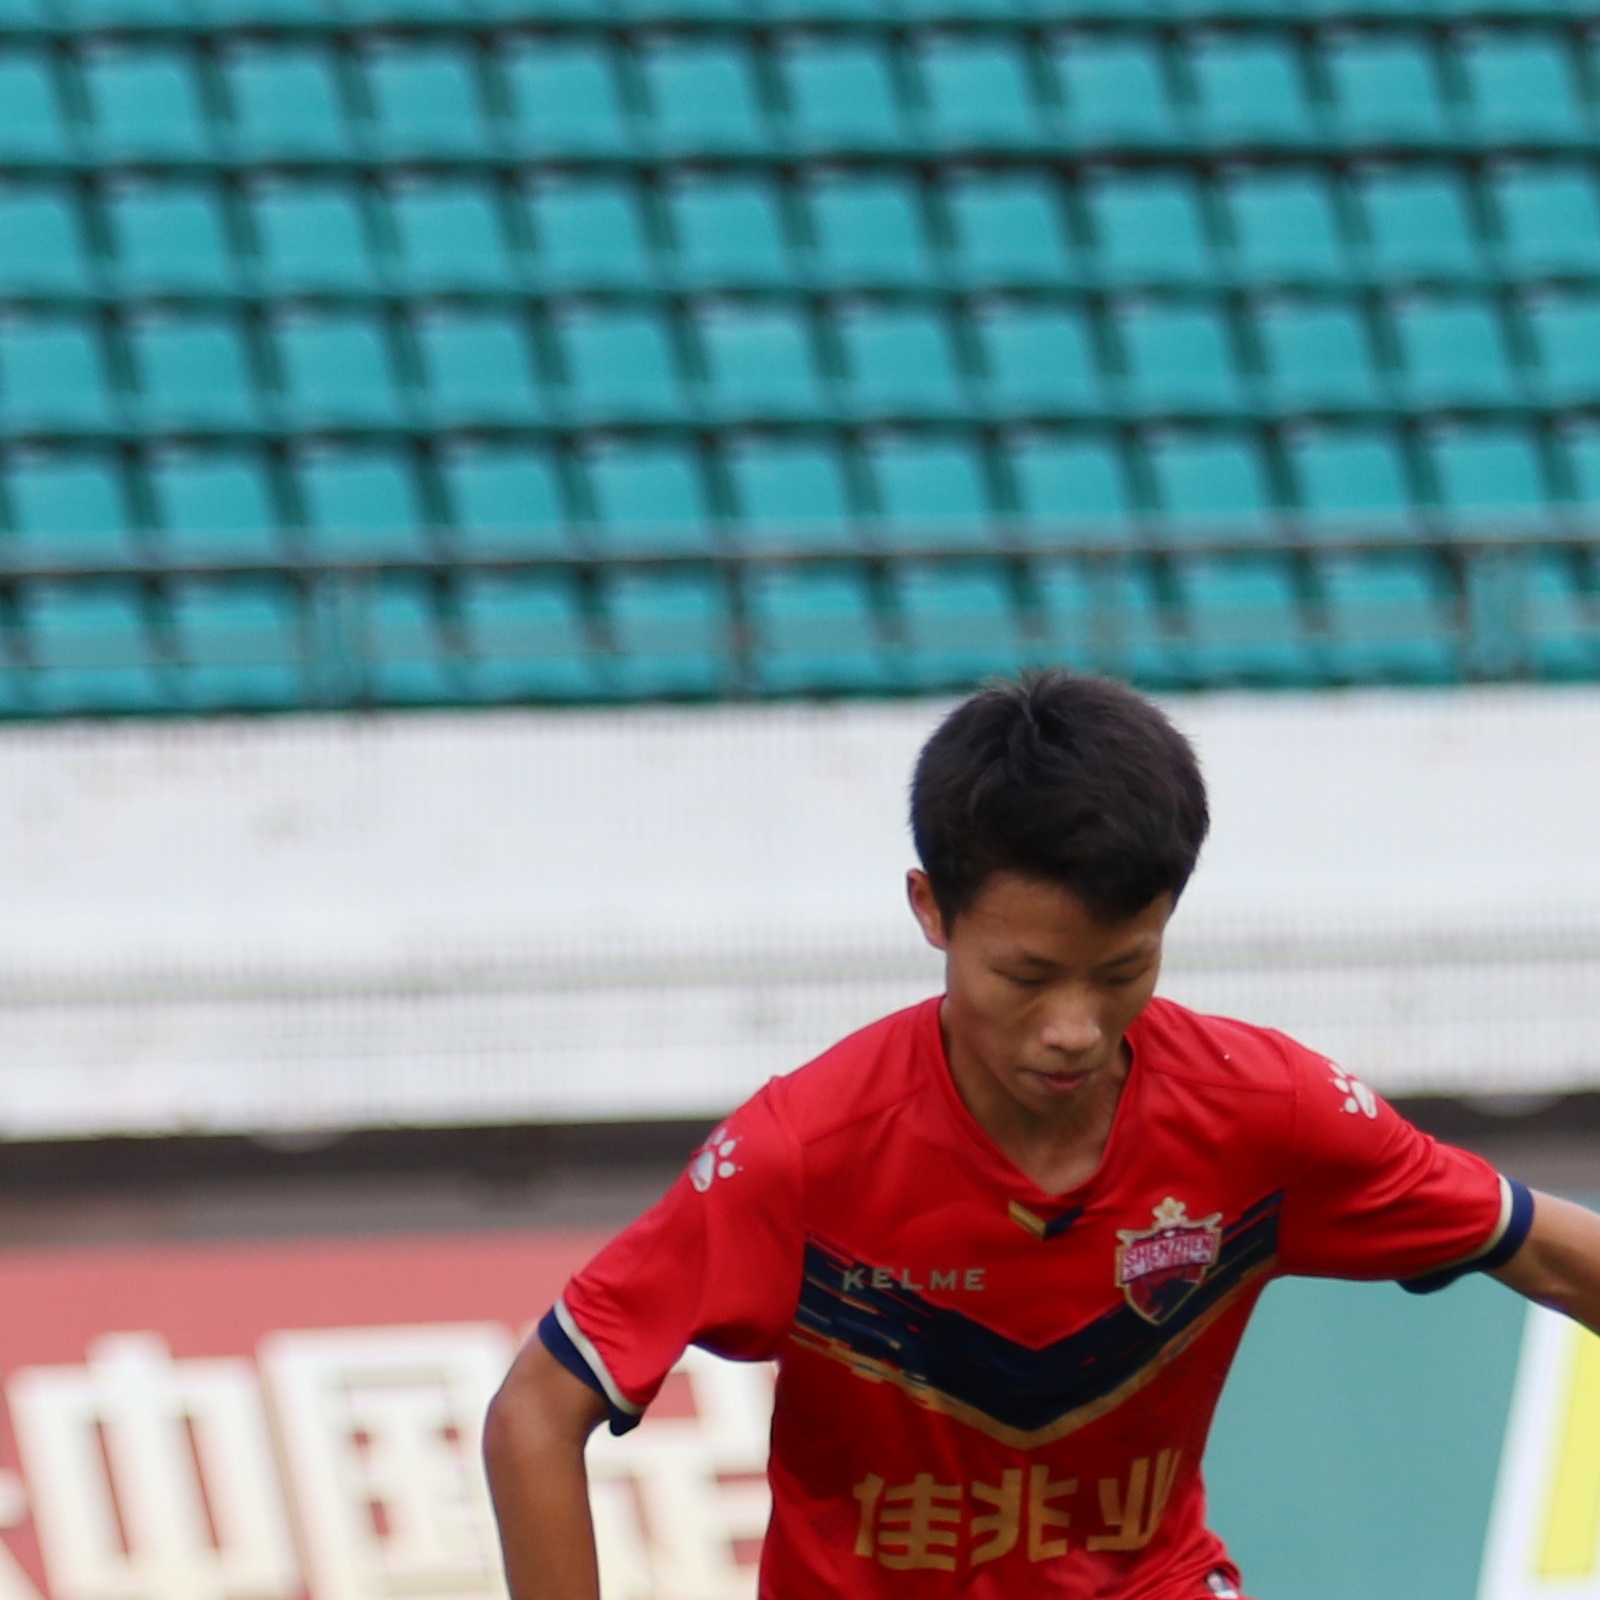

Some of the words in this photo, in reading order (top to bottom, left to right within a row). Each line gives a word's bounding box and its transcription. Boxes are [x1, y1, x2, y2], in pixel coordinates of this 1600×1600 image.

[842, 1266, 987, 1292] KELME
[853, 1448, 1180, 1573] 佳兆业
